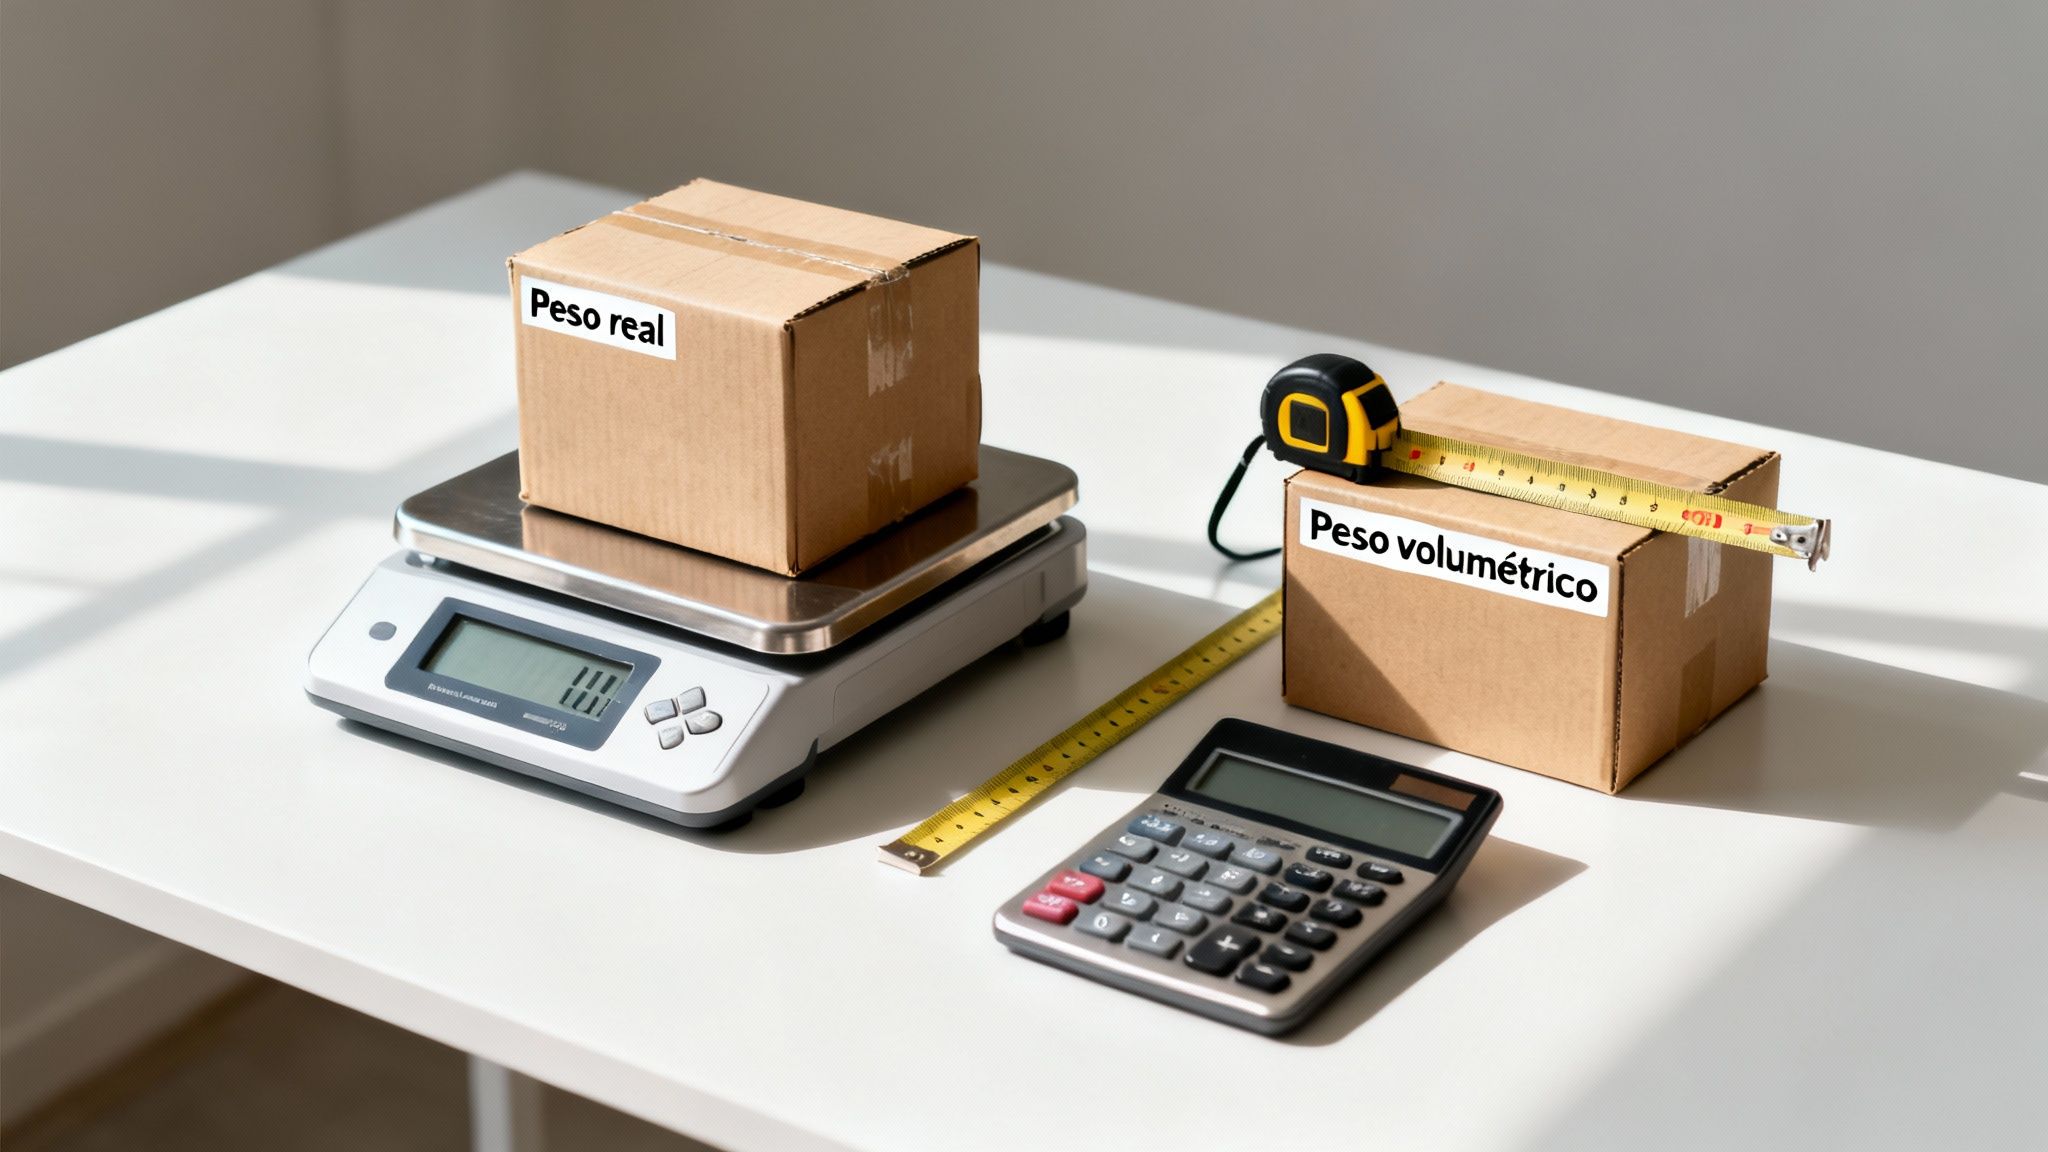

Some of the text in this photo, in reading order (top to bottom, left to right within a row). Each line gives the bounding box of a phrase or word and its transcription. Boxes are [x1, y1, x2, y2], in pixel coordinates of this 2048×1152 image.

[531, 287, 664, 347] Peso real
[1310, 508, 1598, 603] Peso volumétrico
